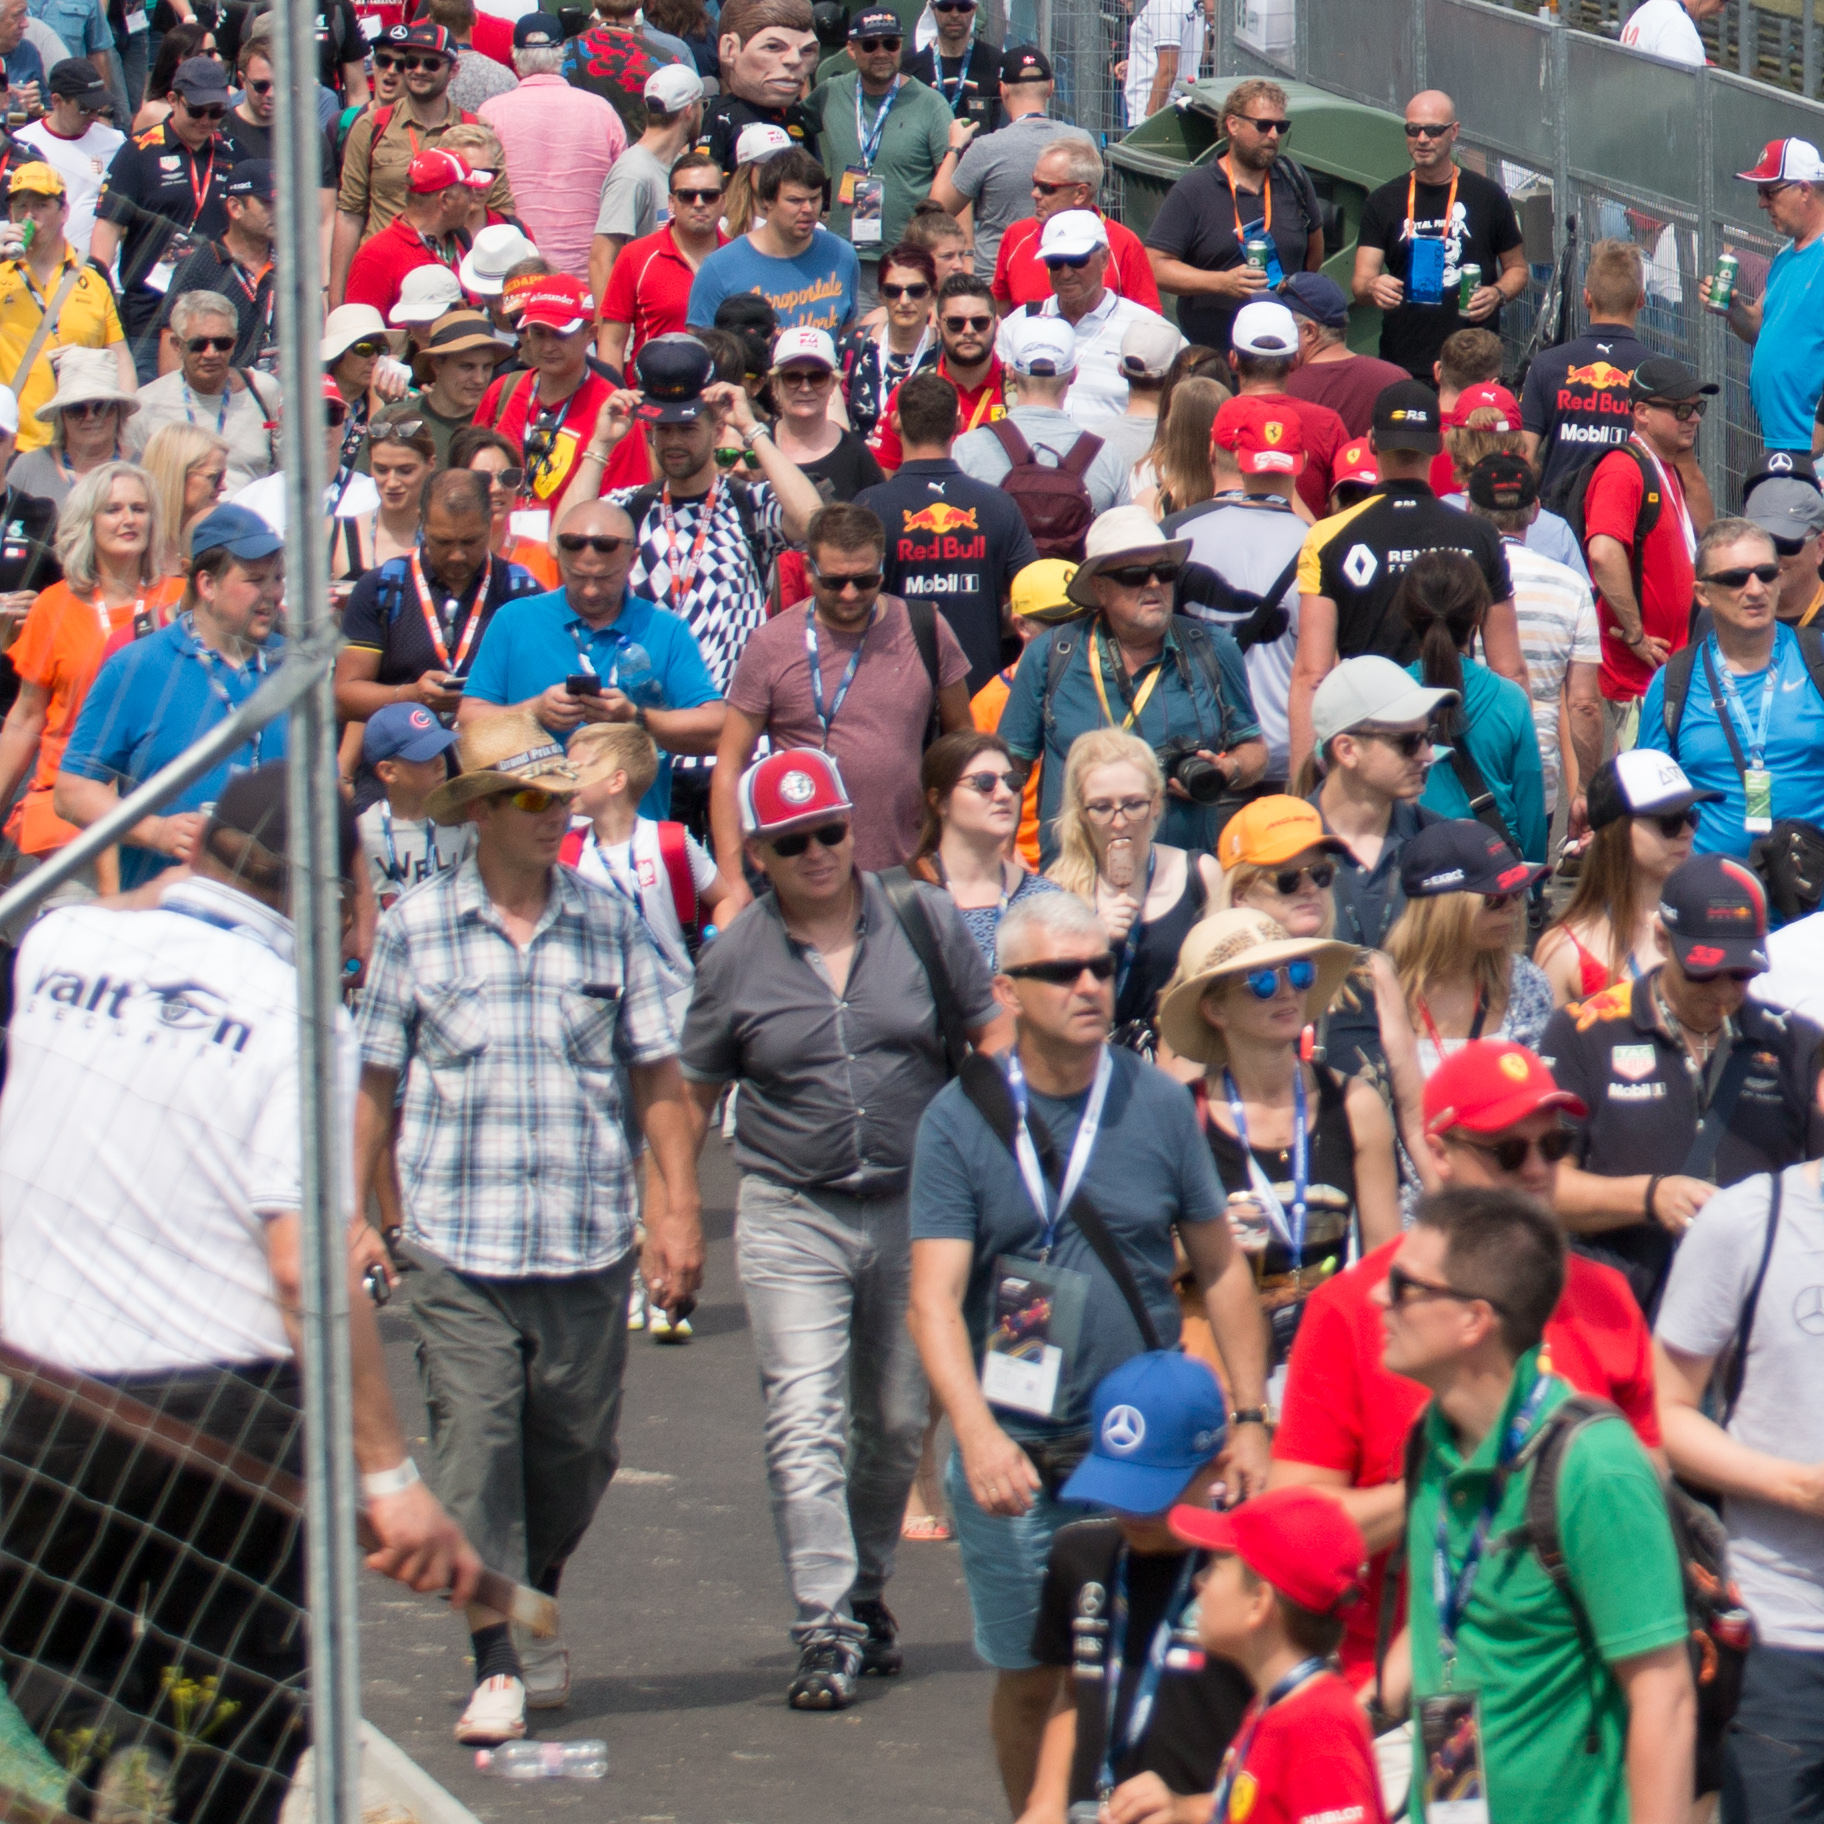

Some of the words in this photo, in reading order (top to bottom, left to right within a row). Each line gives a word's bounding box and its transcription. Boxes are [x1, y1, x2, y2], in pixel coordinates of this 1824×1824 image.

[1557, 389, 1598, 412] Red
[1560, 422, 1609, 444] Mobil
[898, 537, 940, 560] Red
[942, 535, 986, 559] Bull
[904, 572, 958, 594] Mobil
